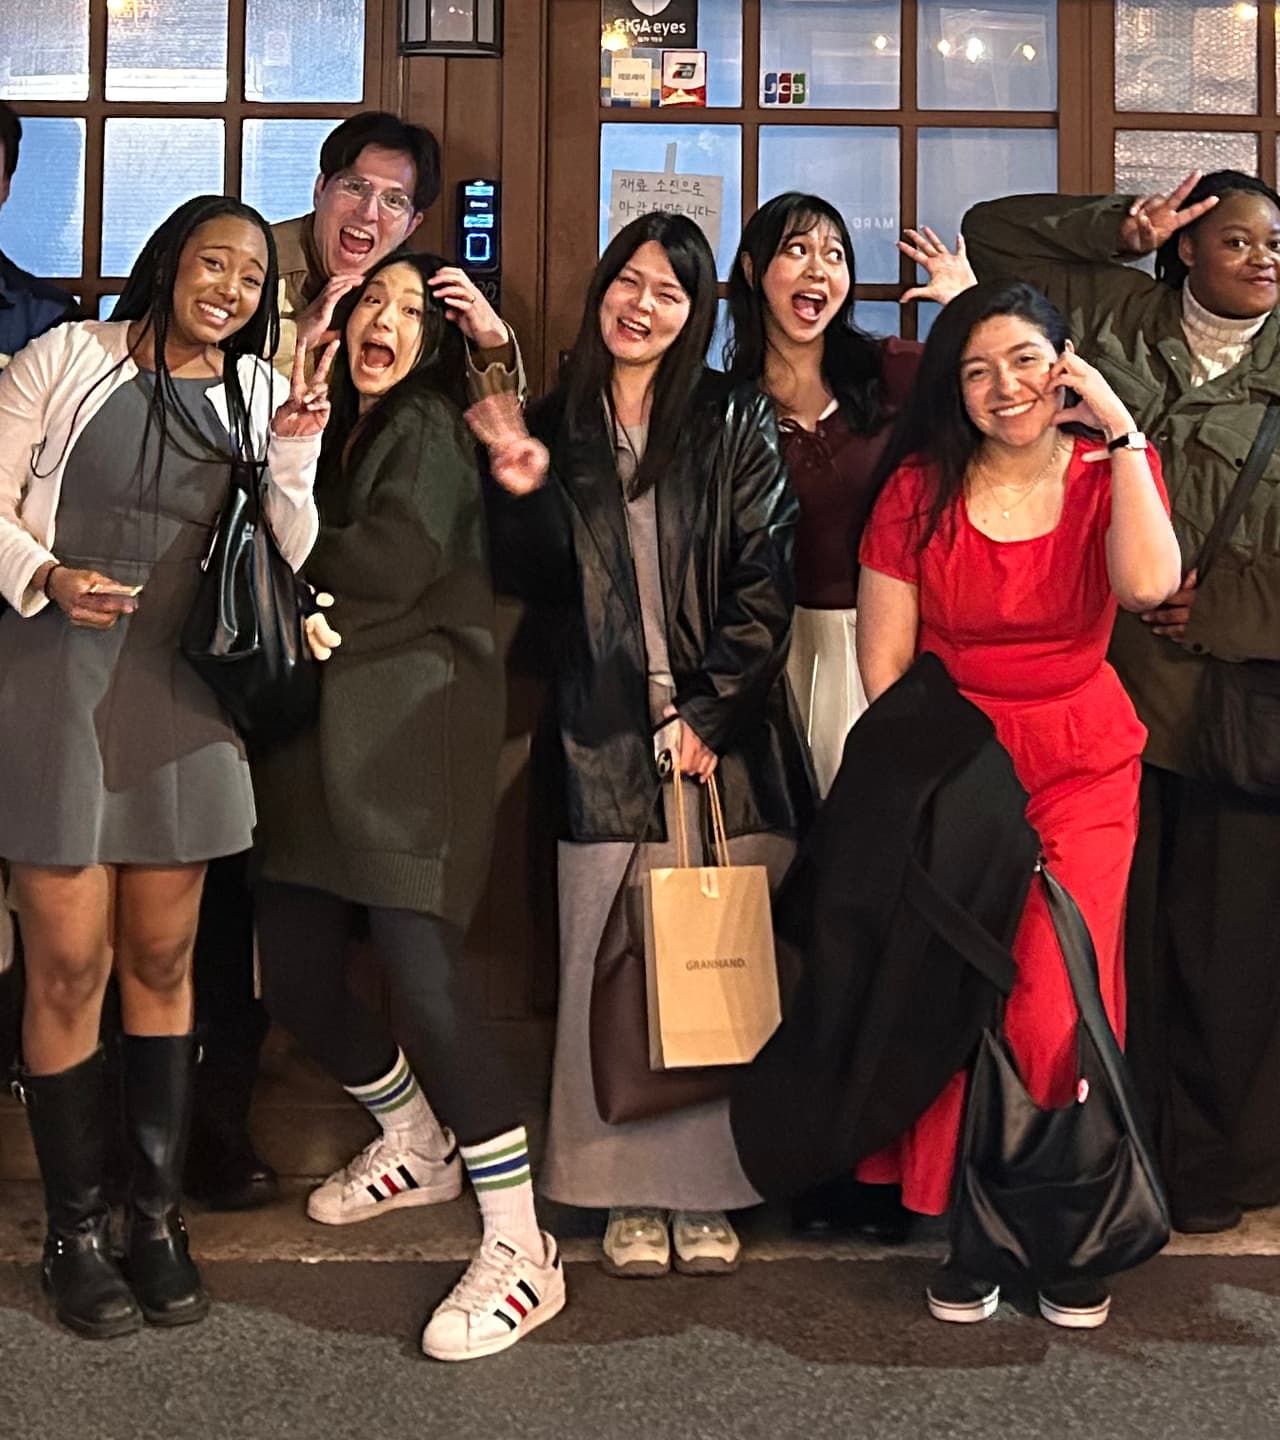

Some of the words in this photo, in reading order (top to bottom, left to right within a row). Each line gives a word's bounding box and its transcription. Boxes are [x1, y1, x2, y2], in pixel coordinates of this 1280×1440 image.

[653, 22, 686, 36] eyes
[620, 178, 649, 193] 재료
[653, 179, 705, 198] 소진으로
[618, 200, 649, 217] 마감
